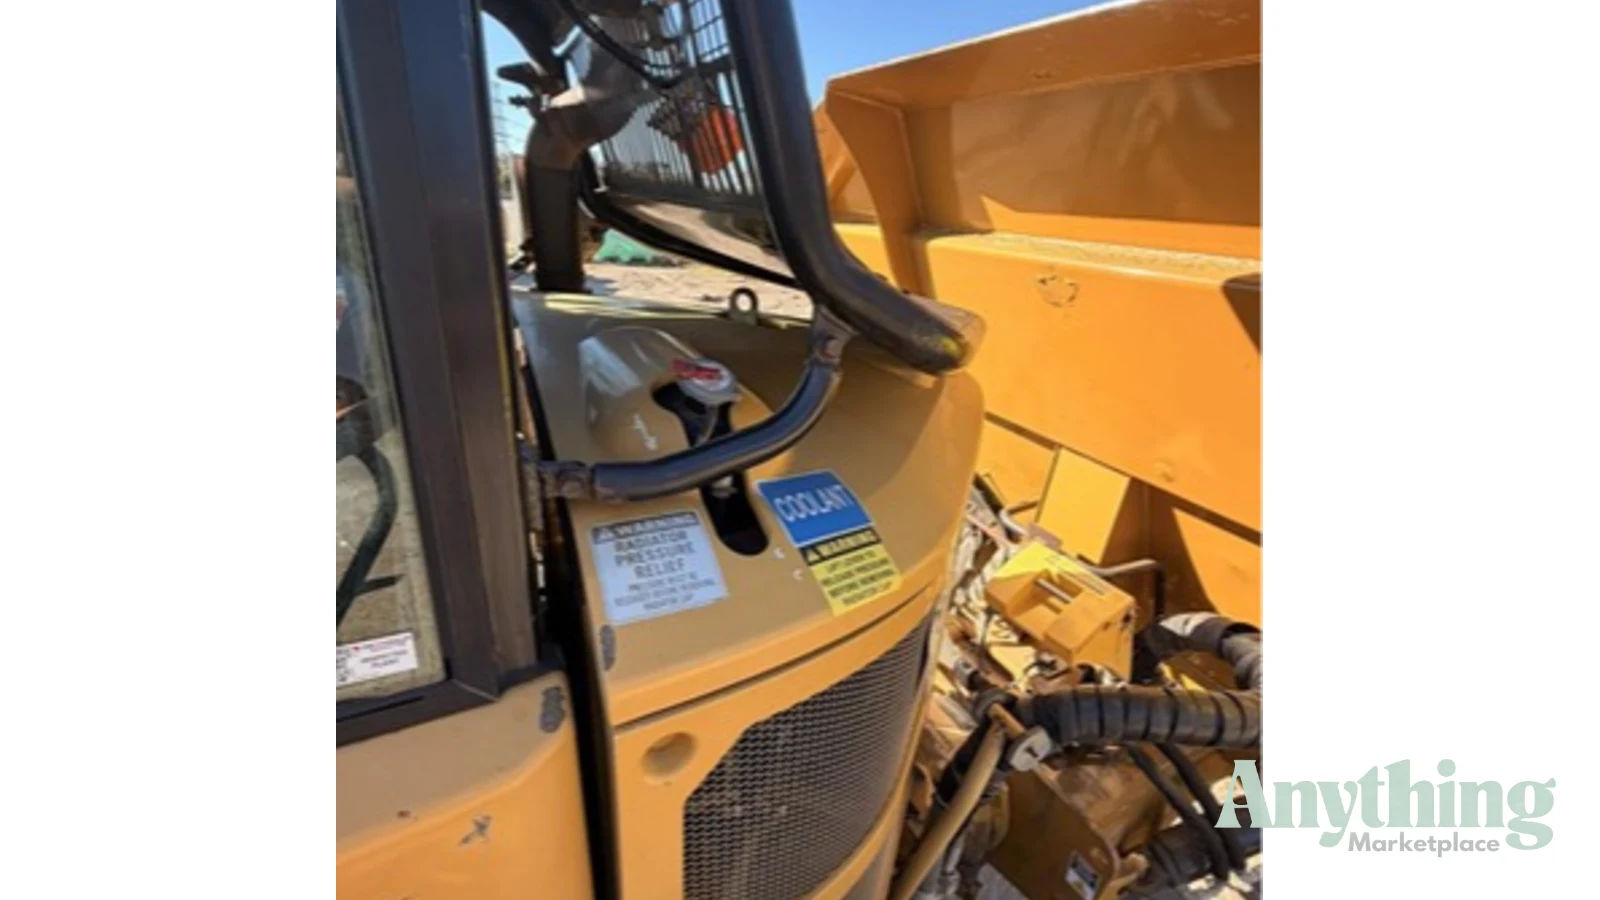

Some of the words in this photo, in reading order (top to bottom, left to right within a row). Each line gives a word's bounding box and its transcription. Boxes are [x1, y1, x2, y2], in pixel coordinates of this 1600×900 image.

[774, 484, 854, 522] COOLANT
[615, 514, 697, 535] WARNING
[614, 530, 688, 551] RADIATOR
[818, 530, 877, 556] WARNING
[615, 541, 696, 567] PRESSURE
[634, 557, 686, 578] RELIEF
